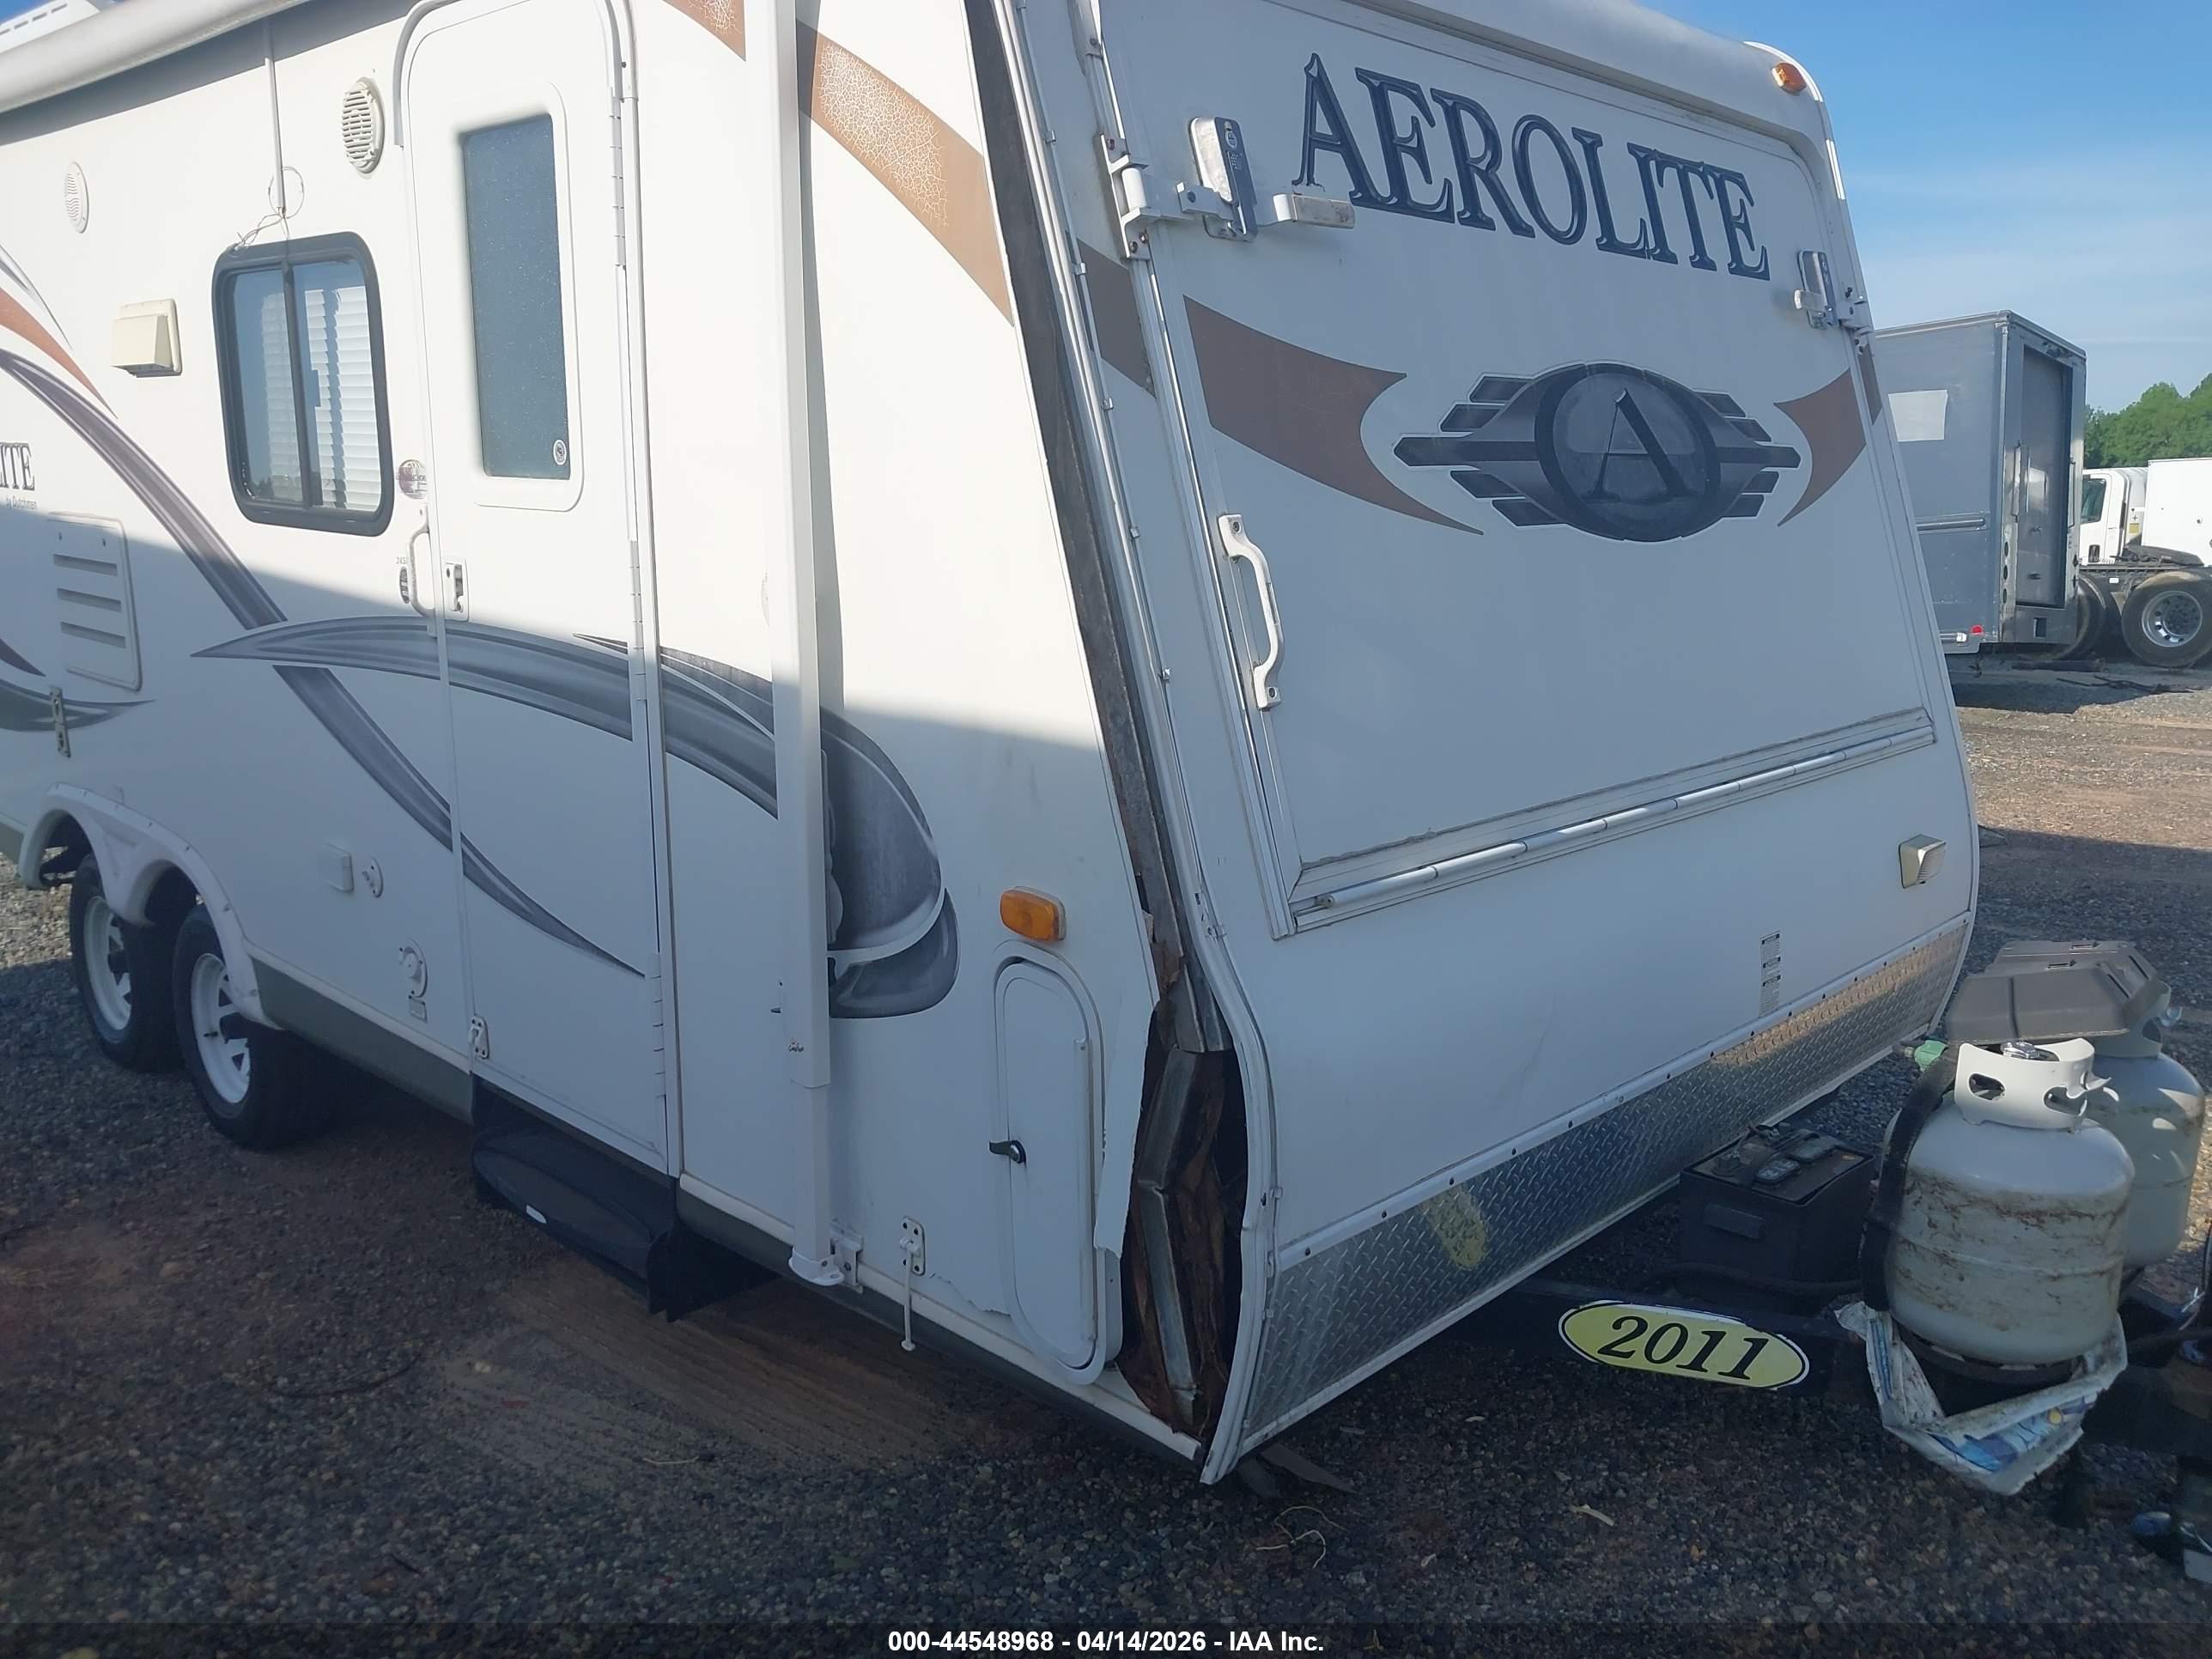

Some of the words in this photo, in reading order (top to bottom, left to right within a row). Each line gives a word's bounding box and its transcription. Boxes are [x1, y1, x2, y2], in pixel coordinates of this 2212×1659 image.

[1291, 52, 1771, 281] AEROLITE
[1581, 388, 1702, 504] A
[1597, 1316, 1769, 1380] 2011
